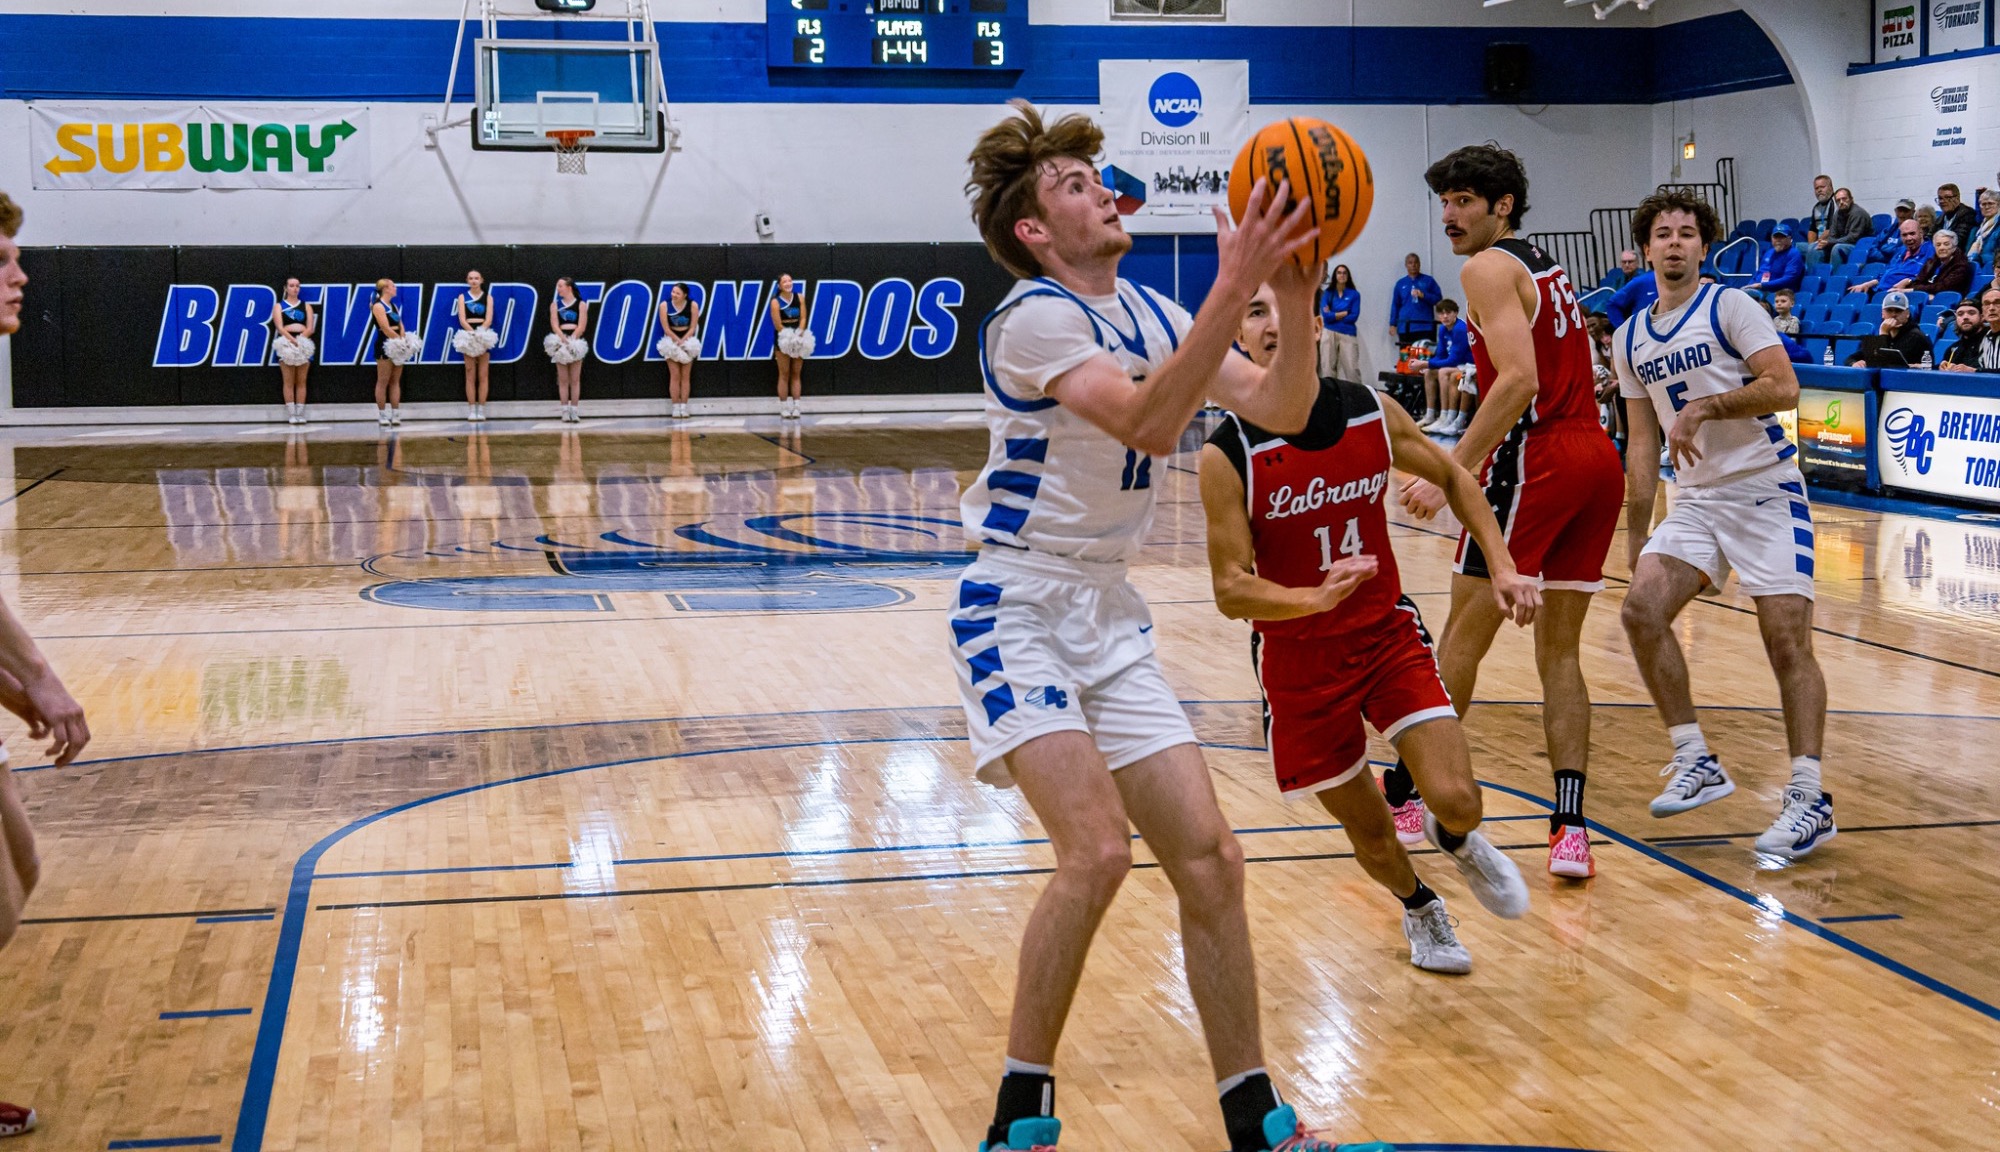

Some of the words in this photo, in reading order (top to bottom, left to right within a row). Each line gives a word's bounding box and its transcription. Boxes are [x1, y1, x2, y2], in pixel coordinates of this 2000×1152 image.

[797, 19, 821, 35] FLS
[877, 20, 922, 36] PLAYER
[978, 22, 1001, 37] FLS
[1944, 11, 1980, 28] TORNADOS
[809, 38, 825, 64] 2
[1882, 33, 1914, 49] PIZZA
[882, 40, 927, 63] 1-44
[990, 41, 1004, 66] 3
[1154, 98, 1201, 114] NCAA
[1941, 93, 1969, 105] TORNADOS
[43, 119, 358, 178] SUBWAY
[1141, 131, 1196, 146] Division
[1201, 131, 1210, 146] III
[1636, 342, 1713, 387] BREVARD
[1666, 380, 1690, 416] 5
[1905, 414, 1935, 475] BC
[1313, 516, 1364, 572] 14
